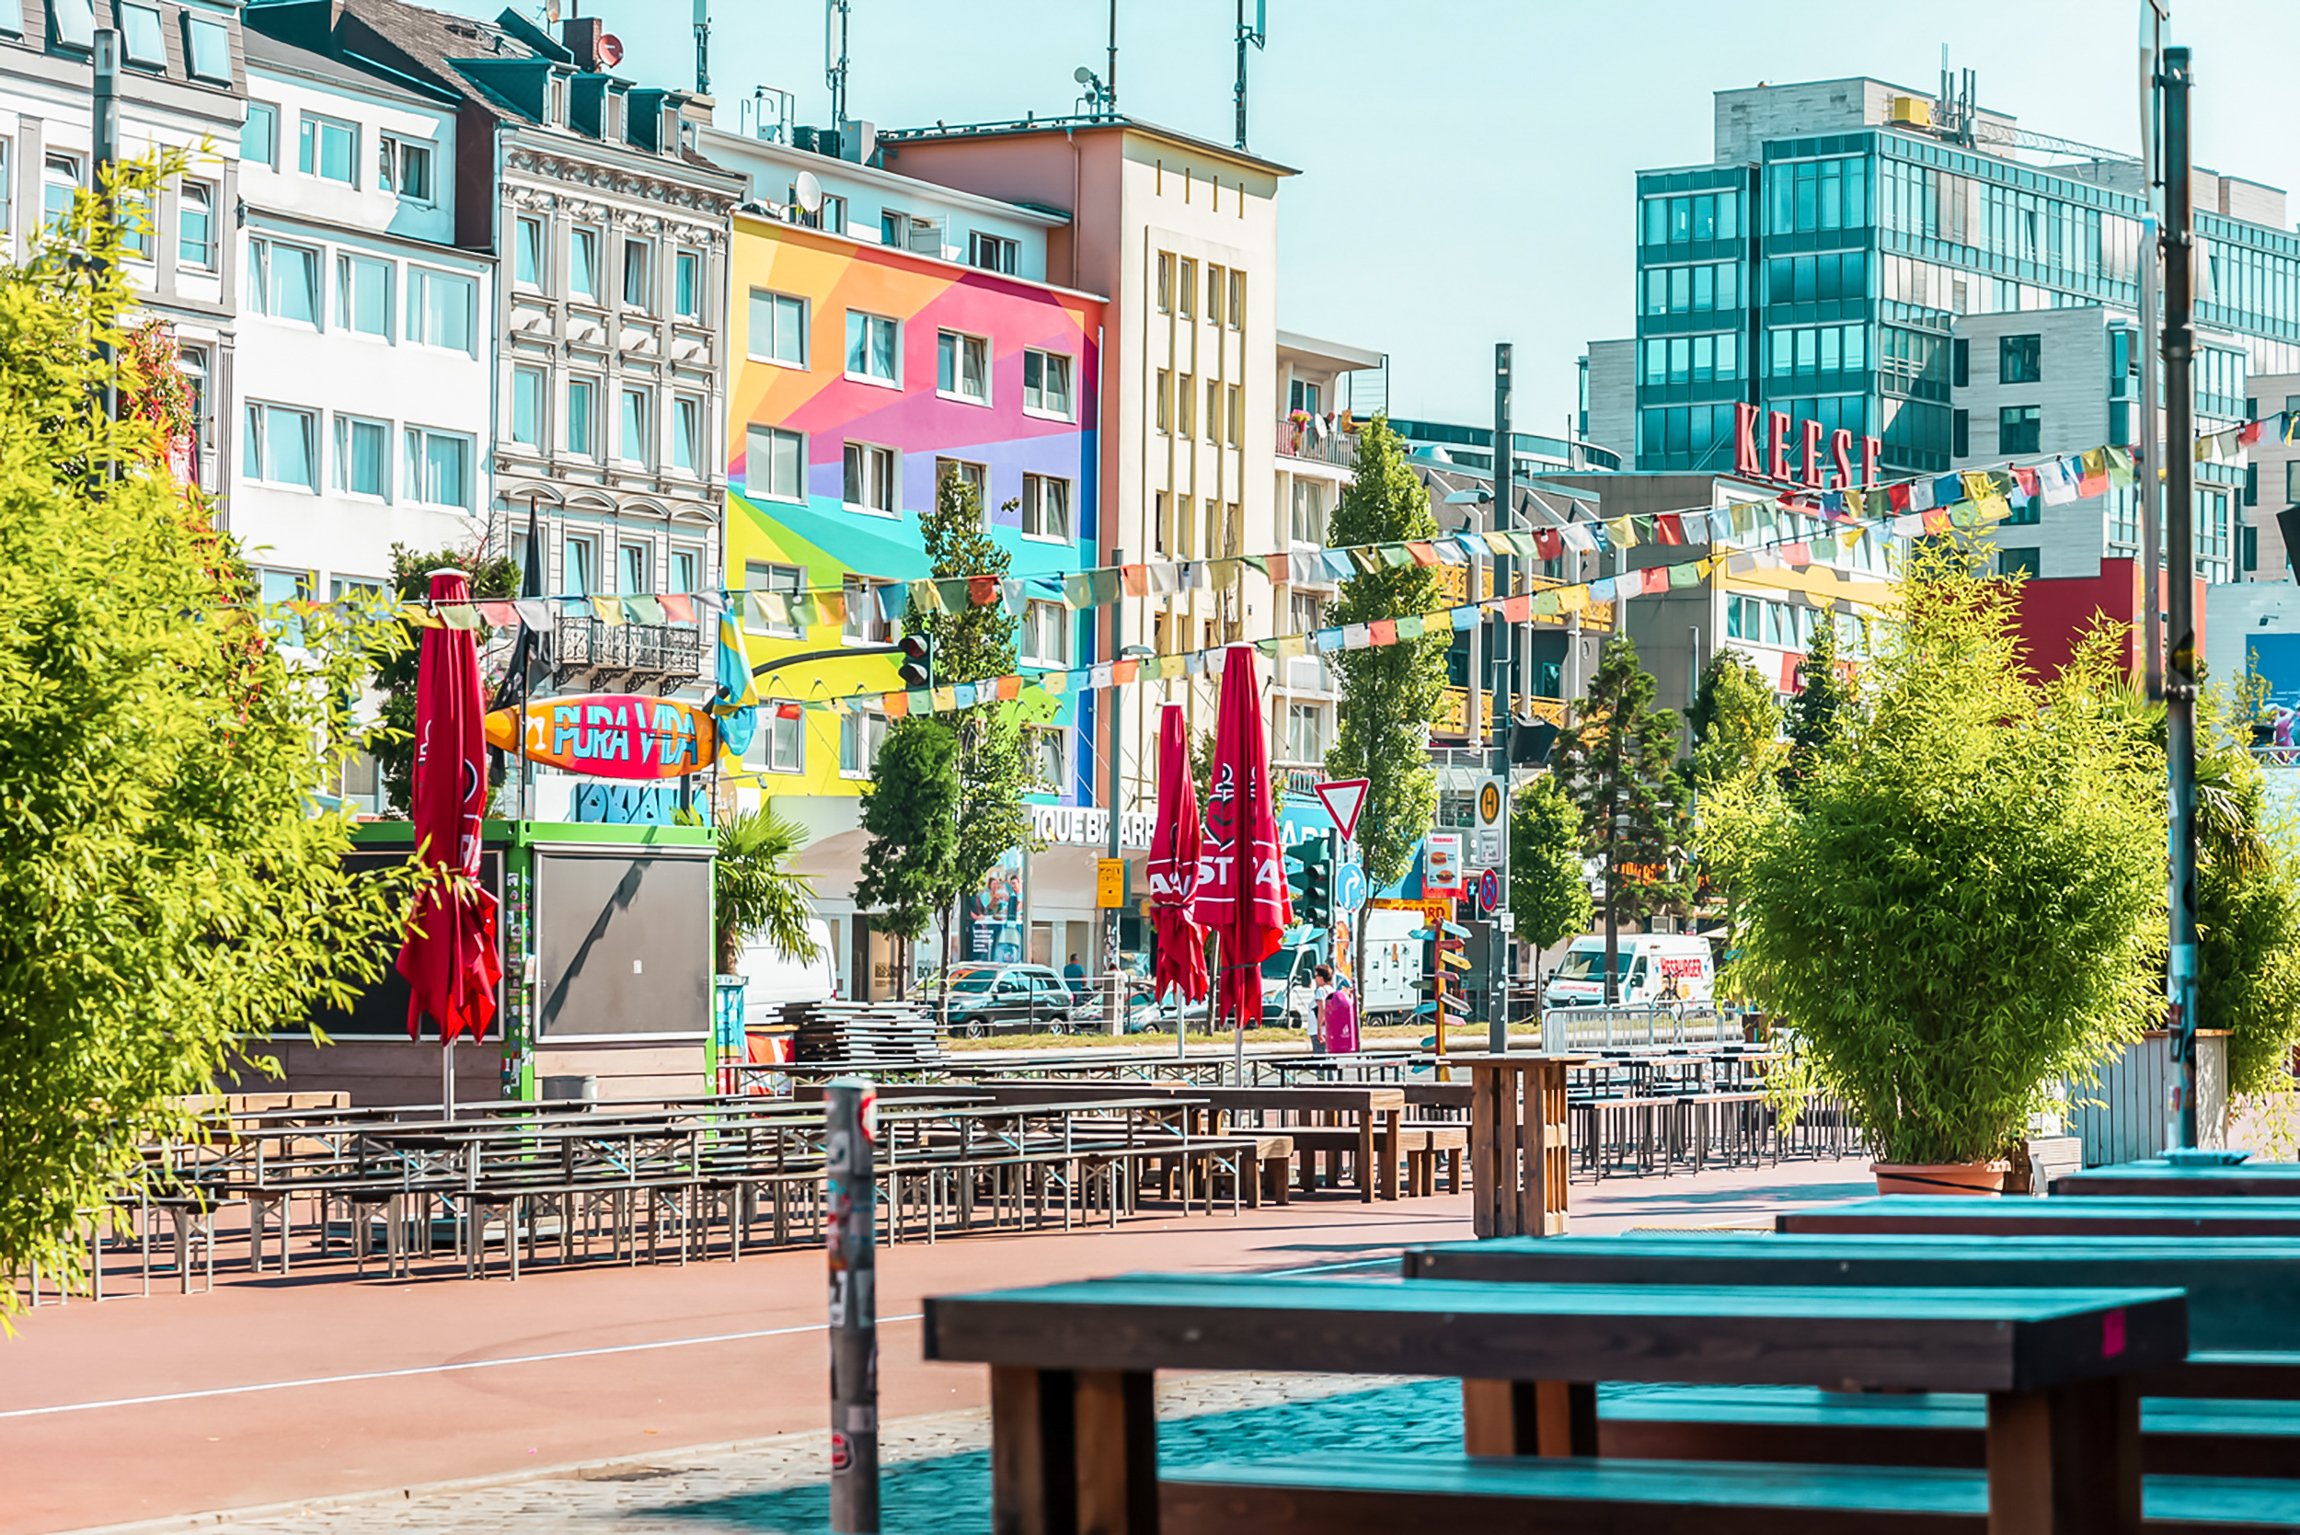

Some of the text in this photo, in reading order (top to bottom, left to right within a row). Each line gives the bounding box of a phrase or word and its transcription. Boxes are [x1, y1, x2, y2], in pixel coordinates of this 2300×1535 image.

[1734, 402, 1882, 491] KEESE
[552, 702, 698, 766] PURA VIDA
[1031, 806, 1085, 844] IQUE
